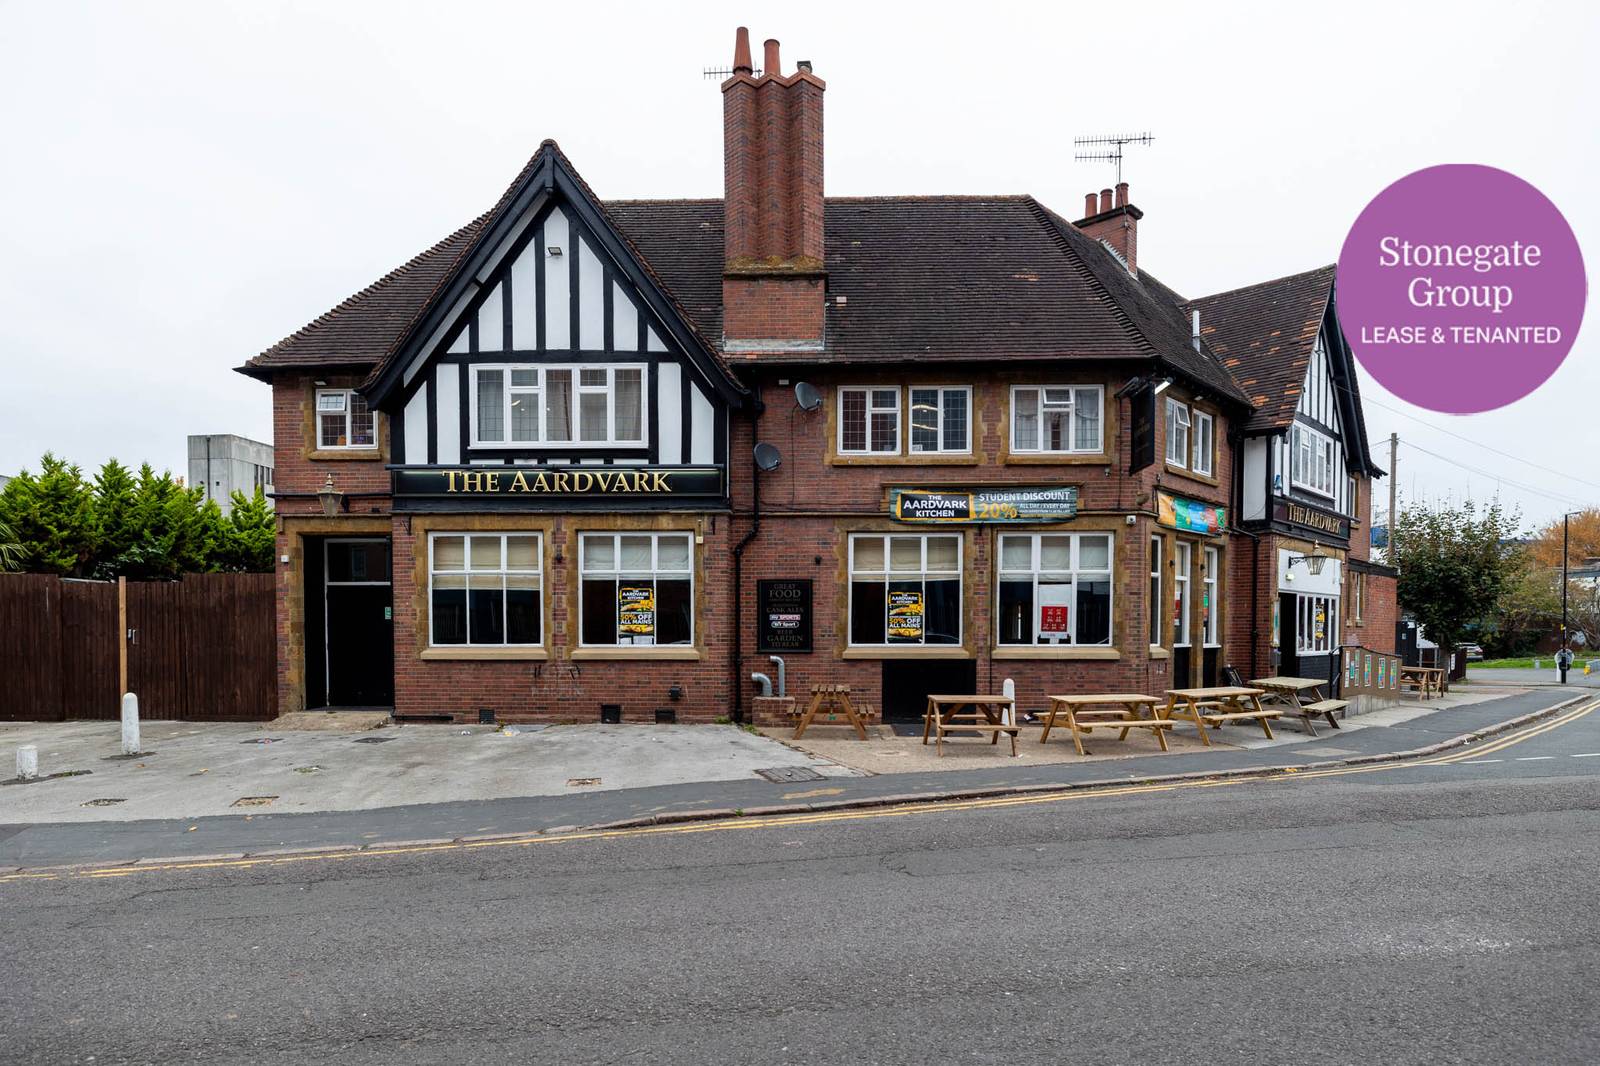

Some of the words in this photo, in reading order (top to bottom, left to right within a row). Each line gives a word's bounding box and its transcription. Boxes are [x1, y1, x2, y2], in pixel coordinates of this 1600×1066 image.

[442, 470, 500, 492] THE
[508, 470, 672, 492] AARDVARK
[979, 493, 1020, 501] STUDENT
[1023, 491, 1070, 500] DISCOUNT
[903, 500, 967, 509] AARDVARK
[979, 503, 1018, 519] 20%
[1288, 502, 1305, 523] THE
[1305, 508, 1341, 533] AARDVARK
[769, 589, 801, 598] FOOD
